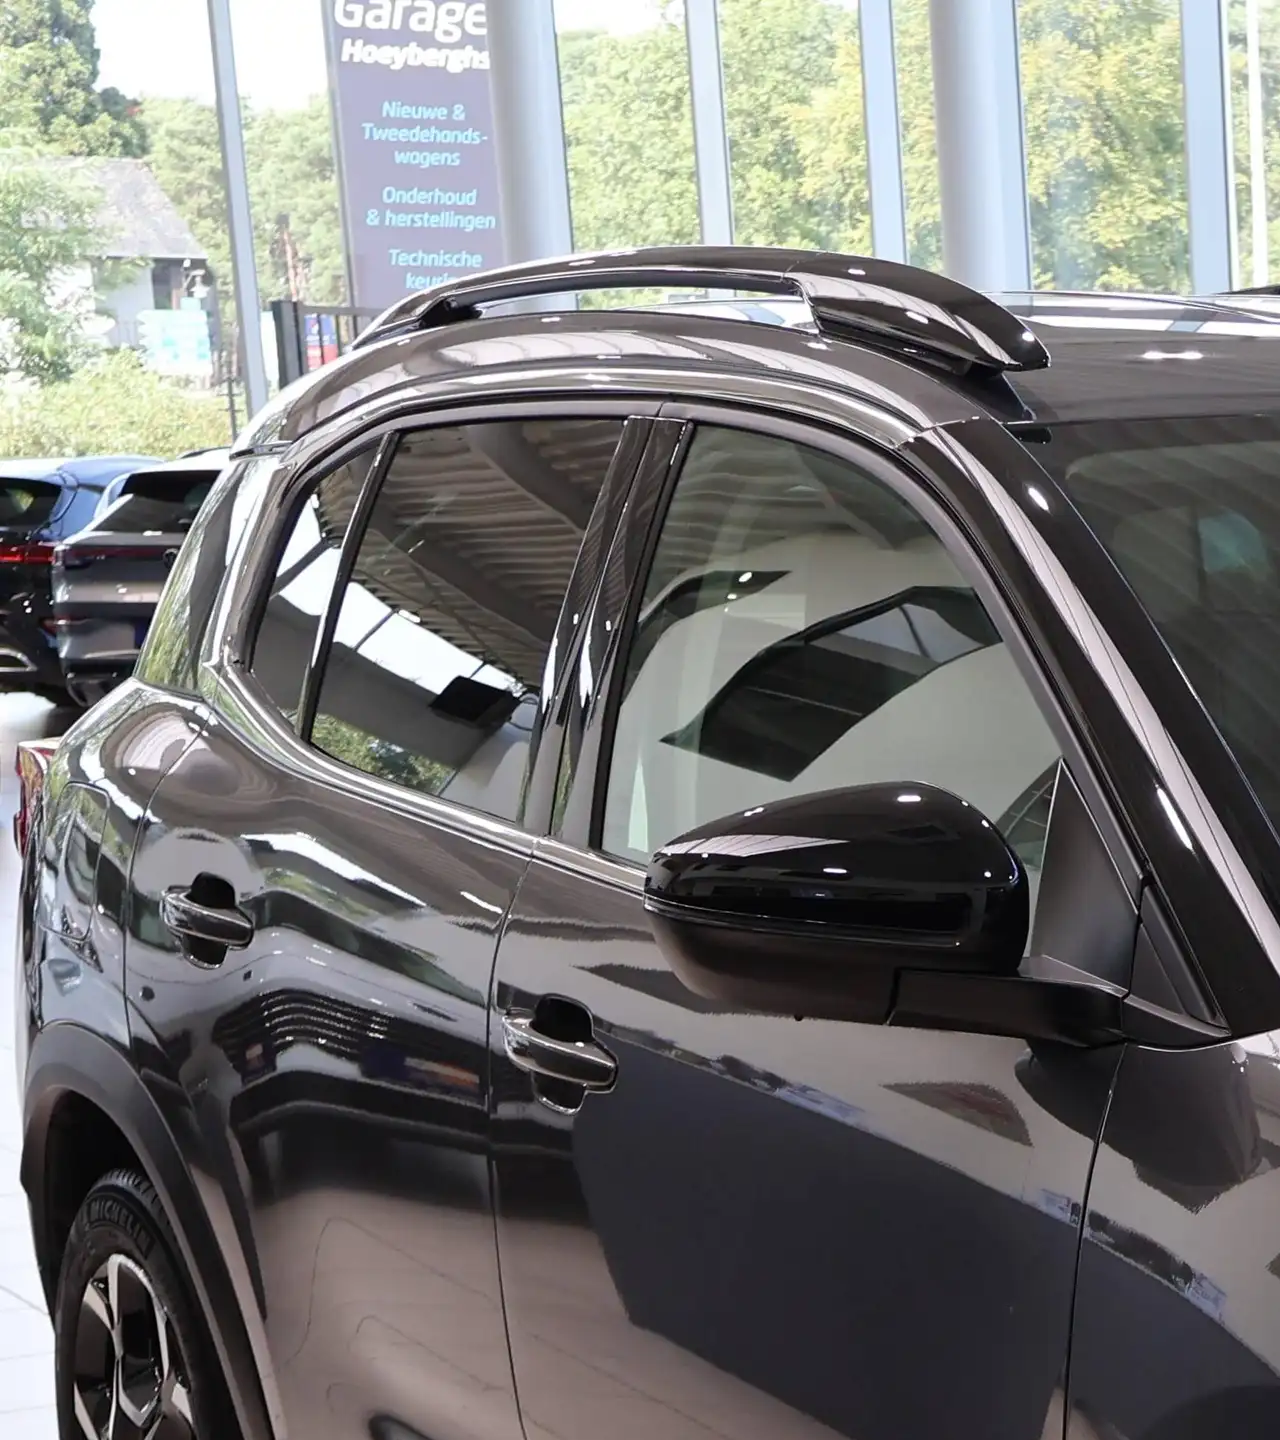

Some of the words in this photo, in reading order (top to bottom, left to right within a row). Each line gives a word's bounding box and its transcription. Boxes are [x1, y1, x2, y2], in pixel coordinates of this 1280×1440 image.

[334, 0, 488, 43] Garage
[341, 38, 490, 73] Hoeyberghs
[382, 101, 448, 120] Nieuwe
[452, 104, 466, 121] &
[361, 123, 488, 145] Tweedehands-
[394, 151, 461, 168] wagens
[382, 186, 477, 205] Onderhoud
[366, 209, 380, 226] &
[384, 209, 496, 232] herstellingen
[389, 249, 482, 268] Technische
